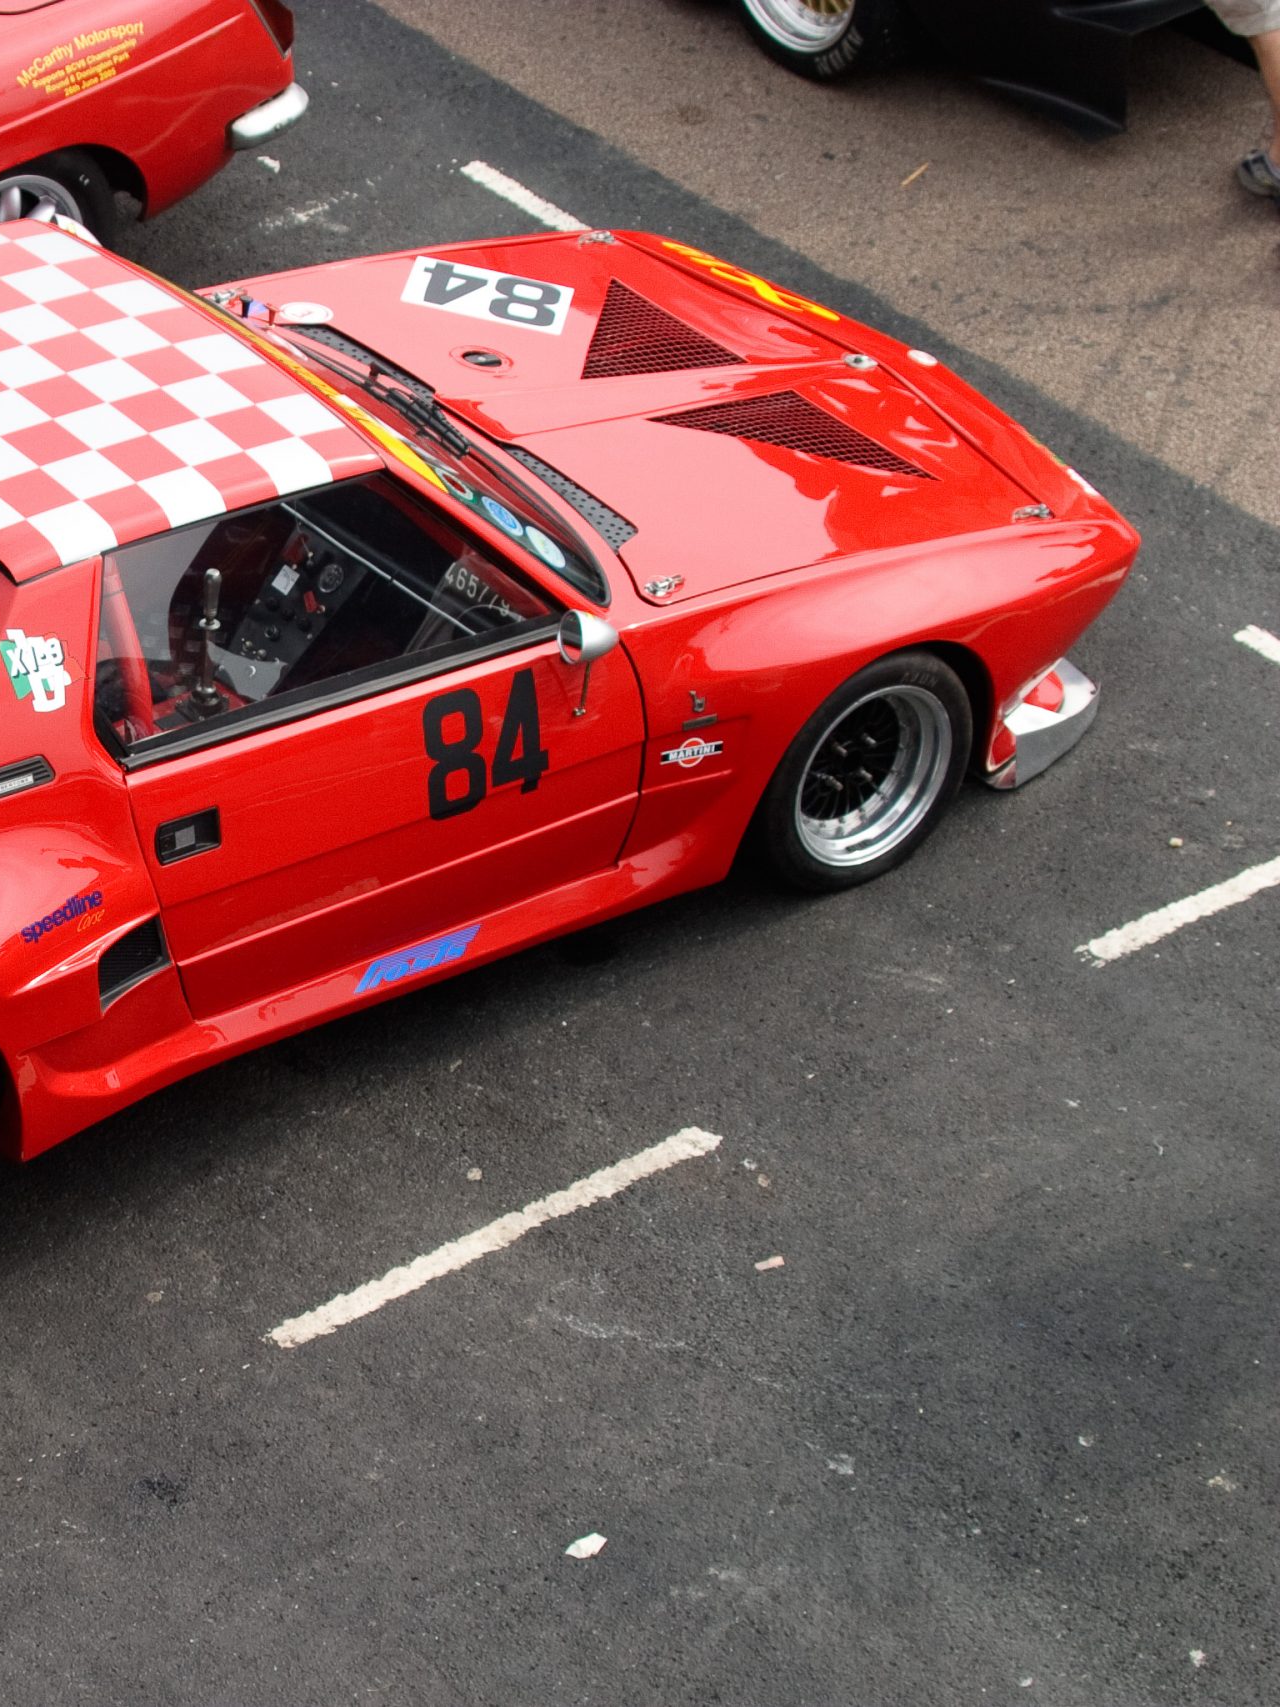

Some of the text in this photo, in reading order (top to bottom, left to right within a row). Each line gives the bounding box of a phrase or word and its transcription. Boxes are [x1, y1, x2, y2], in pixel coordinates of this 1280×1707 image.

[17, 21, 144, 87] McCarthy Motorsport
[423, 261, 562, 327] 84
[423, 667, 549, 821] 84
[669, 744, 715, 761] MARTINI
[21, 890, 103, 943] speedline
